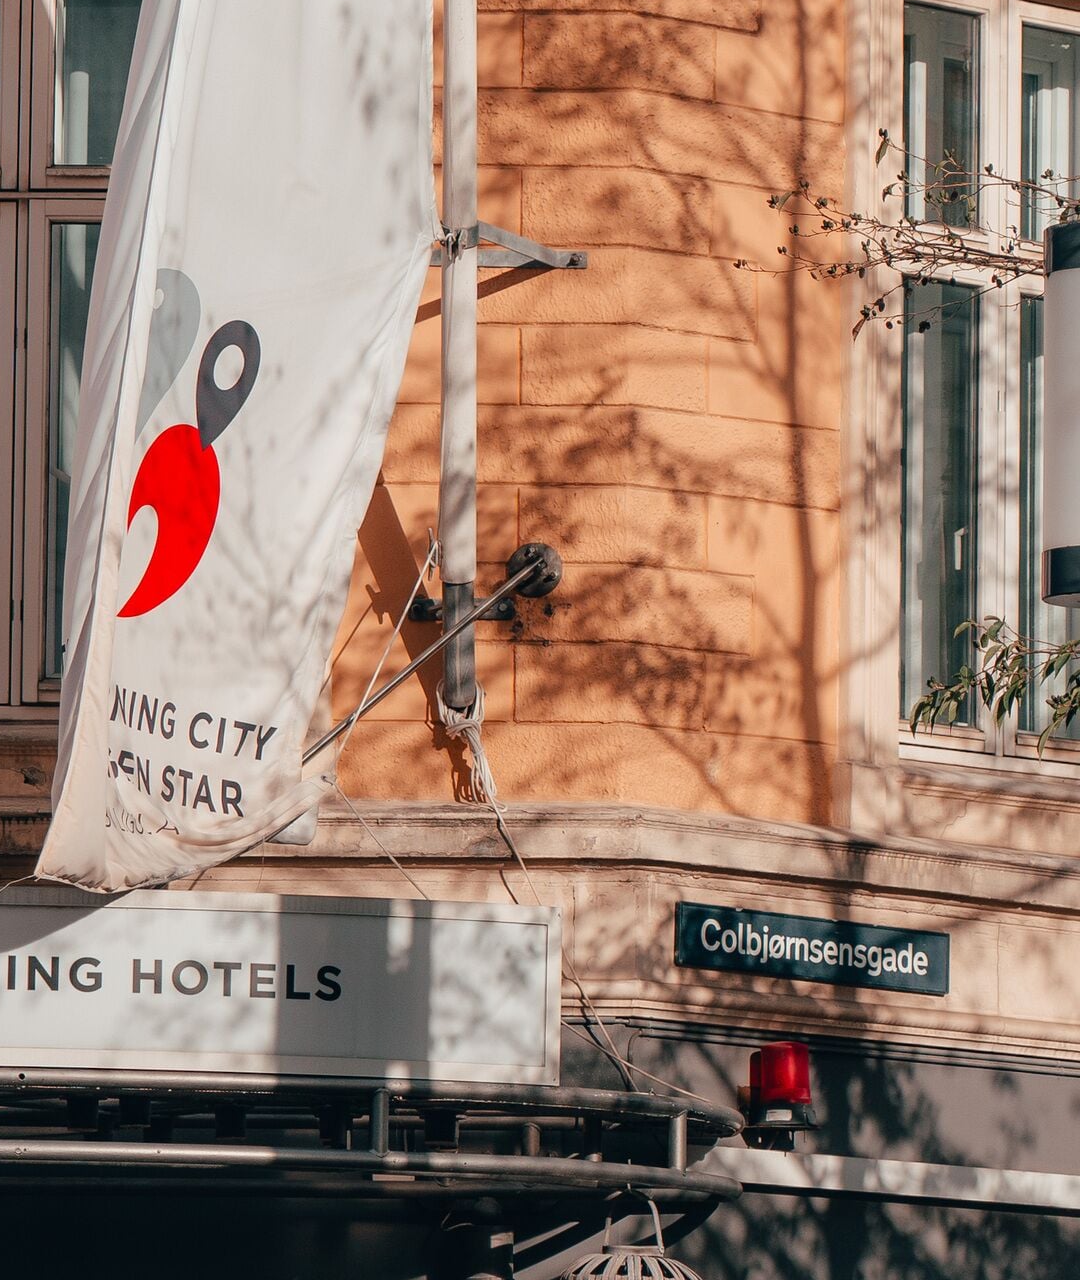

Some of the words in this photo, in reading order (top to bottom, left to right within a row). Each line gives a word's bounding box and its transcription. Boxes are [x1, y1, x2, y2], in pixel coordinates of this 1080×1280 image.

[189, 712, 277, 761] CITY
[161, 765, 244, 818] STAR
[700, 918, 929, 977] Colbjørnsensgade
[132, 958, 343, 1002] HOTELS
